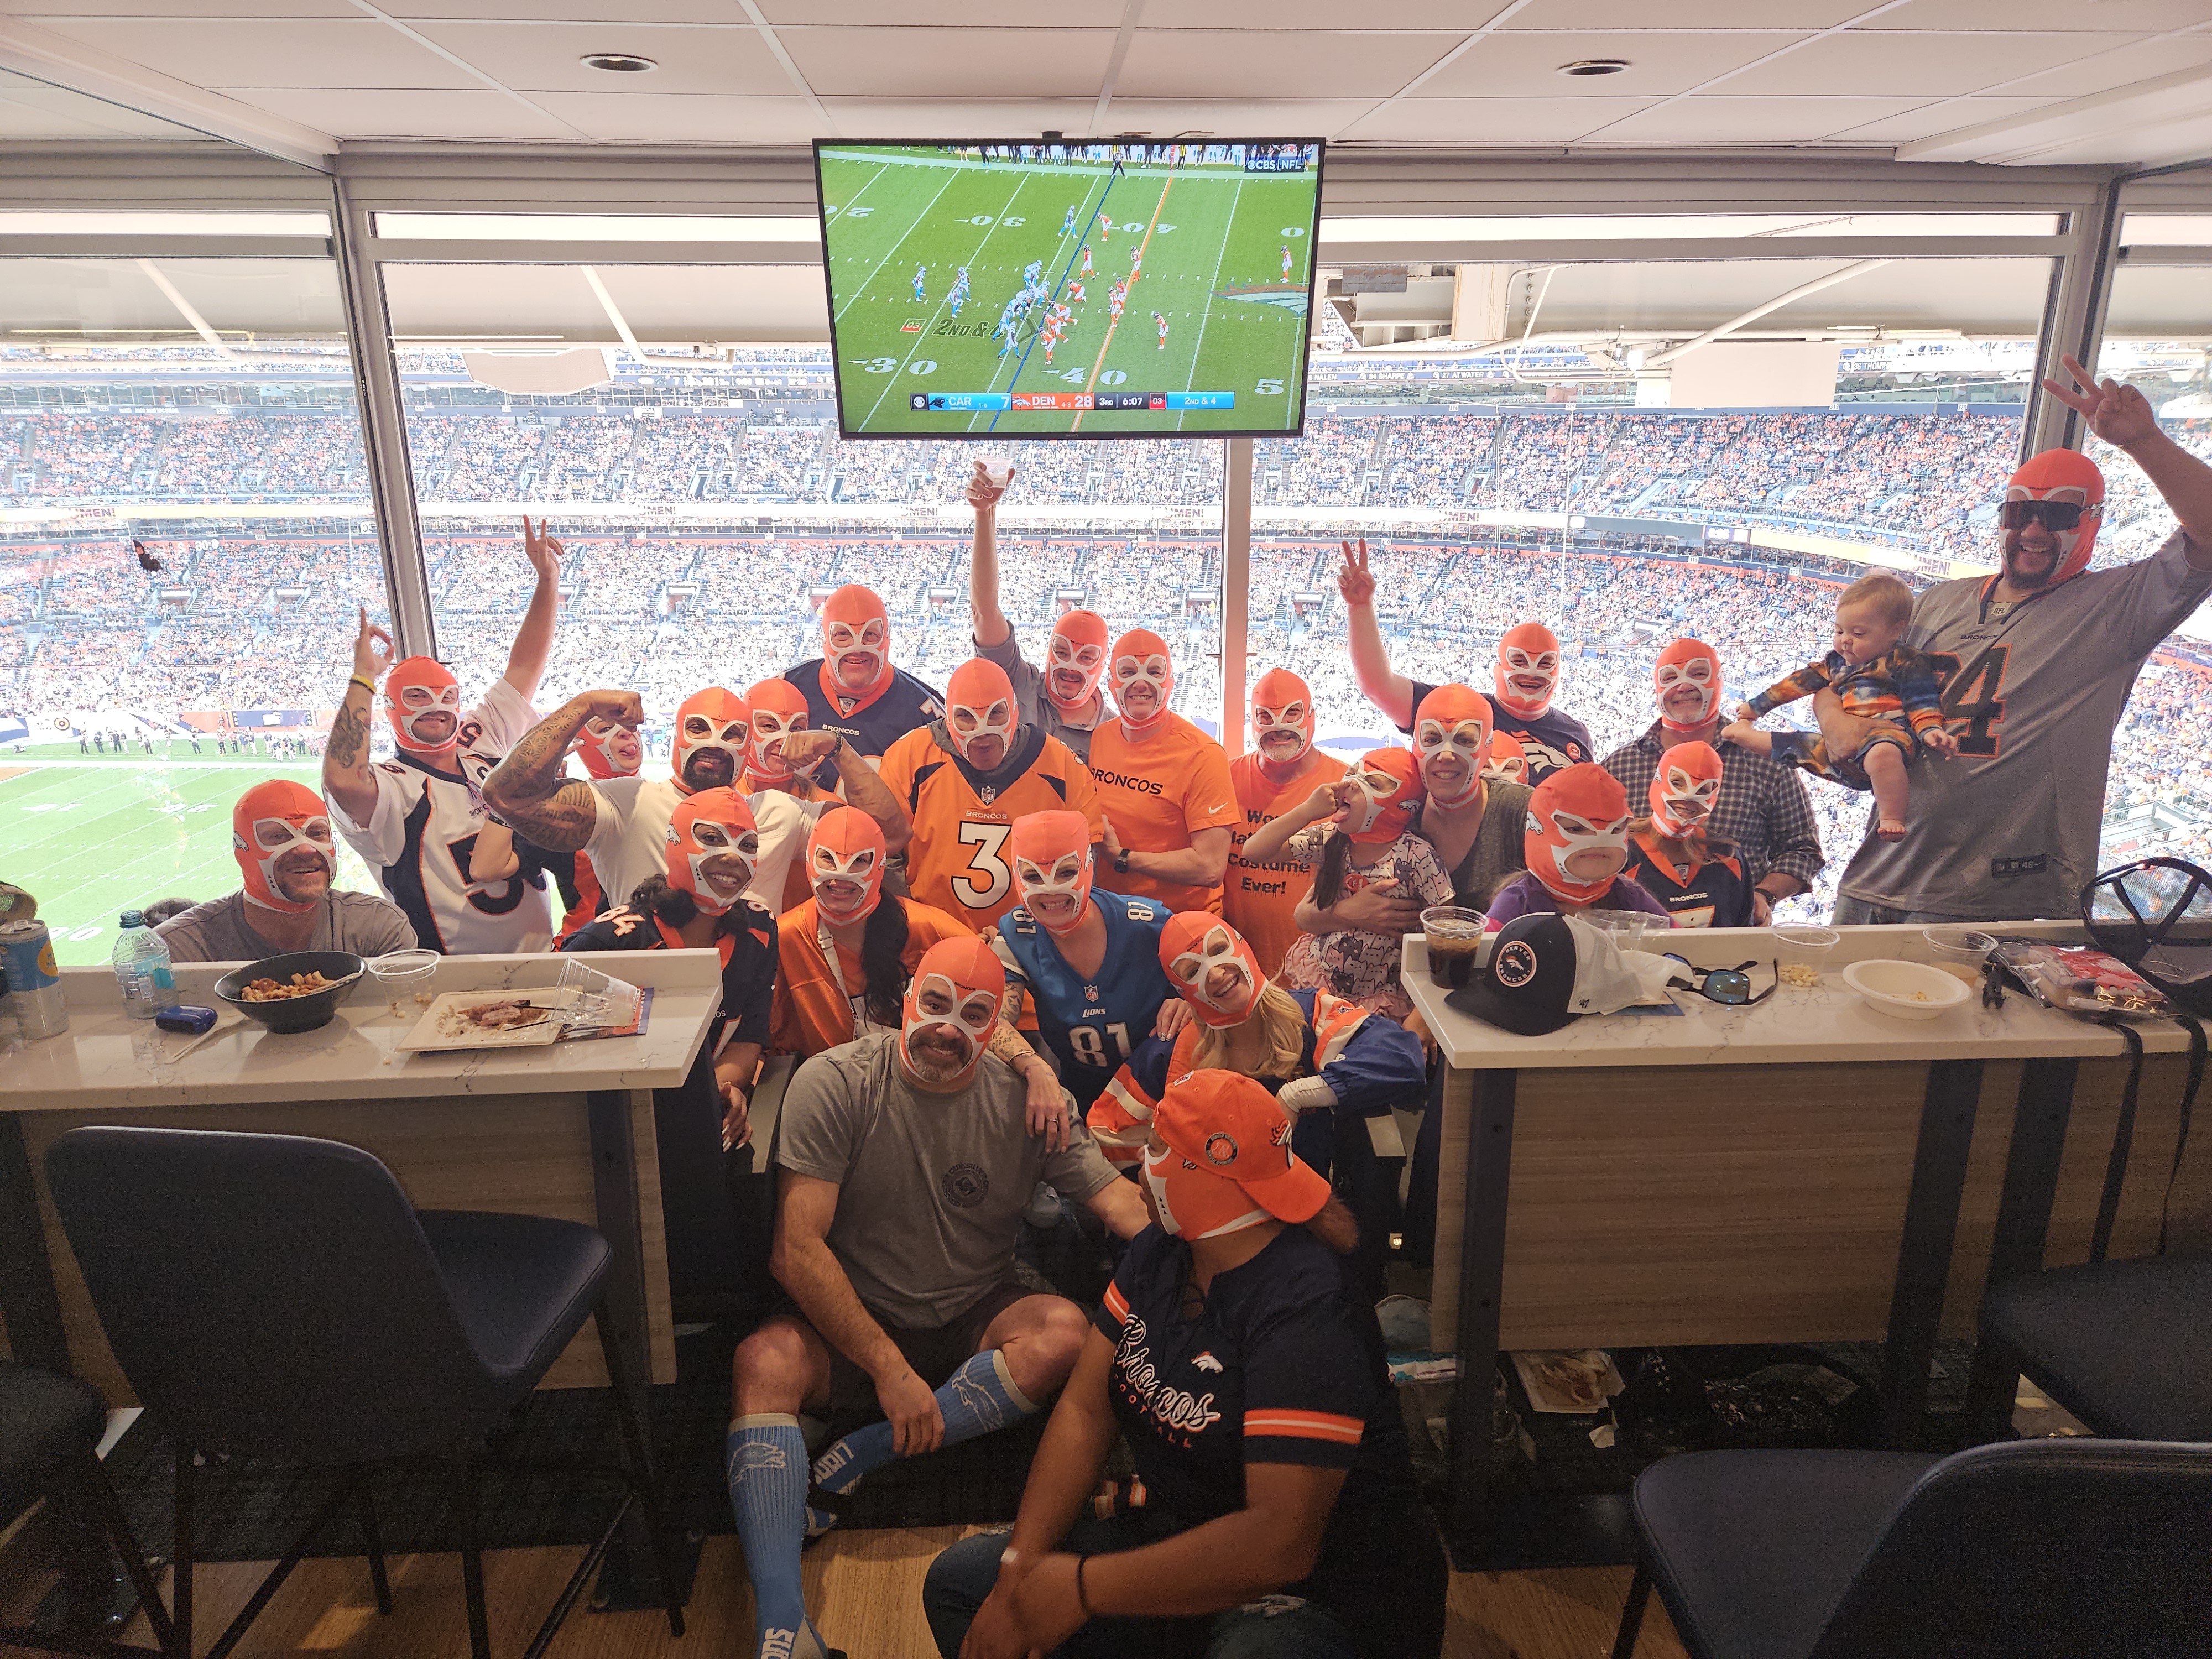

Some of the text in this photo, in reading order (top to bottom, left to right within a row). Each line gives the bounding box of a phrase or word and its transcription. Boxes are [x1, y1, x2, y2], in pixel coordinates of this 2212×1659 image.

[1256, 159, 1301, 170] CBS NFL
[931, 319, 972, 337] 2ND
[1854, 362, 1861, 370] 36
[948, 396, 972, 406] CAR
[1000, 397, 1010, 408] 7
[1032, 396, 1055, 405] DEN
[1074, 395, 1093, 408] 28
[1099, 397, 1143, 406] 3RD 6:07
[822, 724, 860, 736] BRONCOS
[966, 810, 1008, 821] BRONCOS
[1247, 809, 1279, 826] Wo
[950, 820, 1013, 910] 3
[1228, 853, 1310, 875] Costume
[1241, 875, 1286, 894] Ever!
[1669, 892, 1709, 902] BRONCOS
[593, 904, 646, 937] 84
[1505, 946, 1531, 961] DENVER
[1499, 963, 1528, 983] BRONCOS
[1082, 1007, 1107, 1018] LIONS
[1068, 1022, 1133, 1068] 81
[1113, 1313, 1221, 1433] Broncos
[813, 1441, 855, 1485] LION
